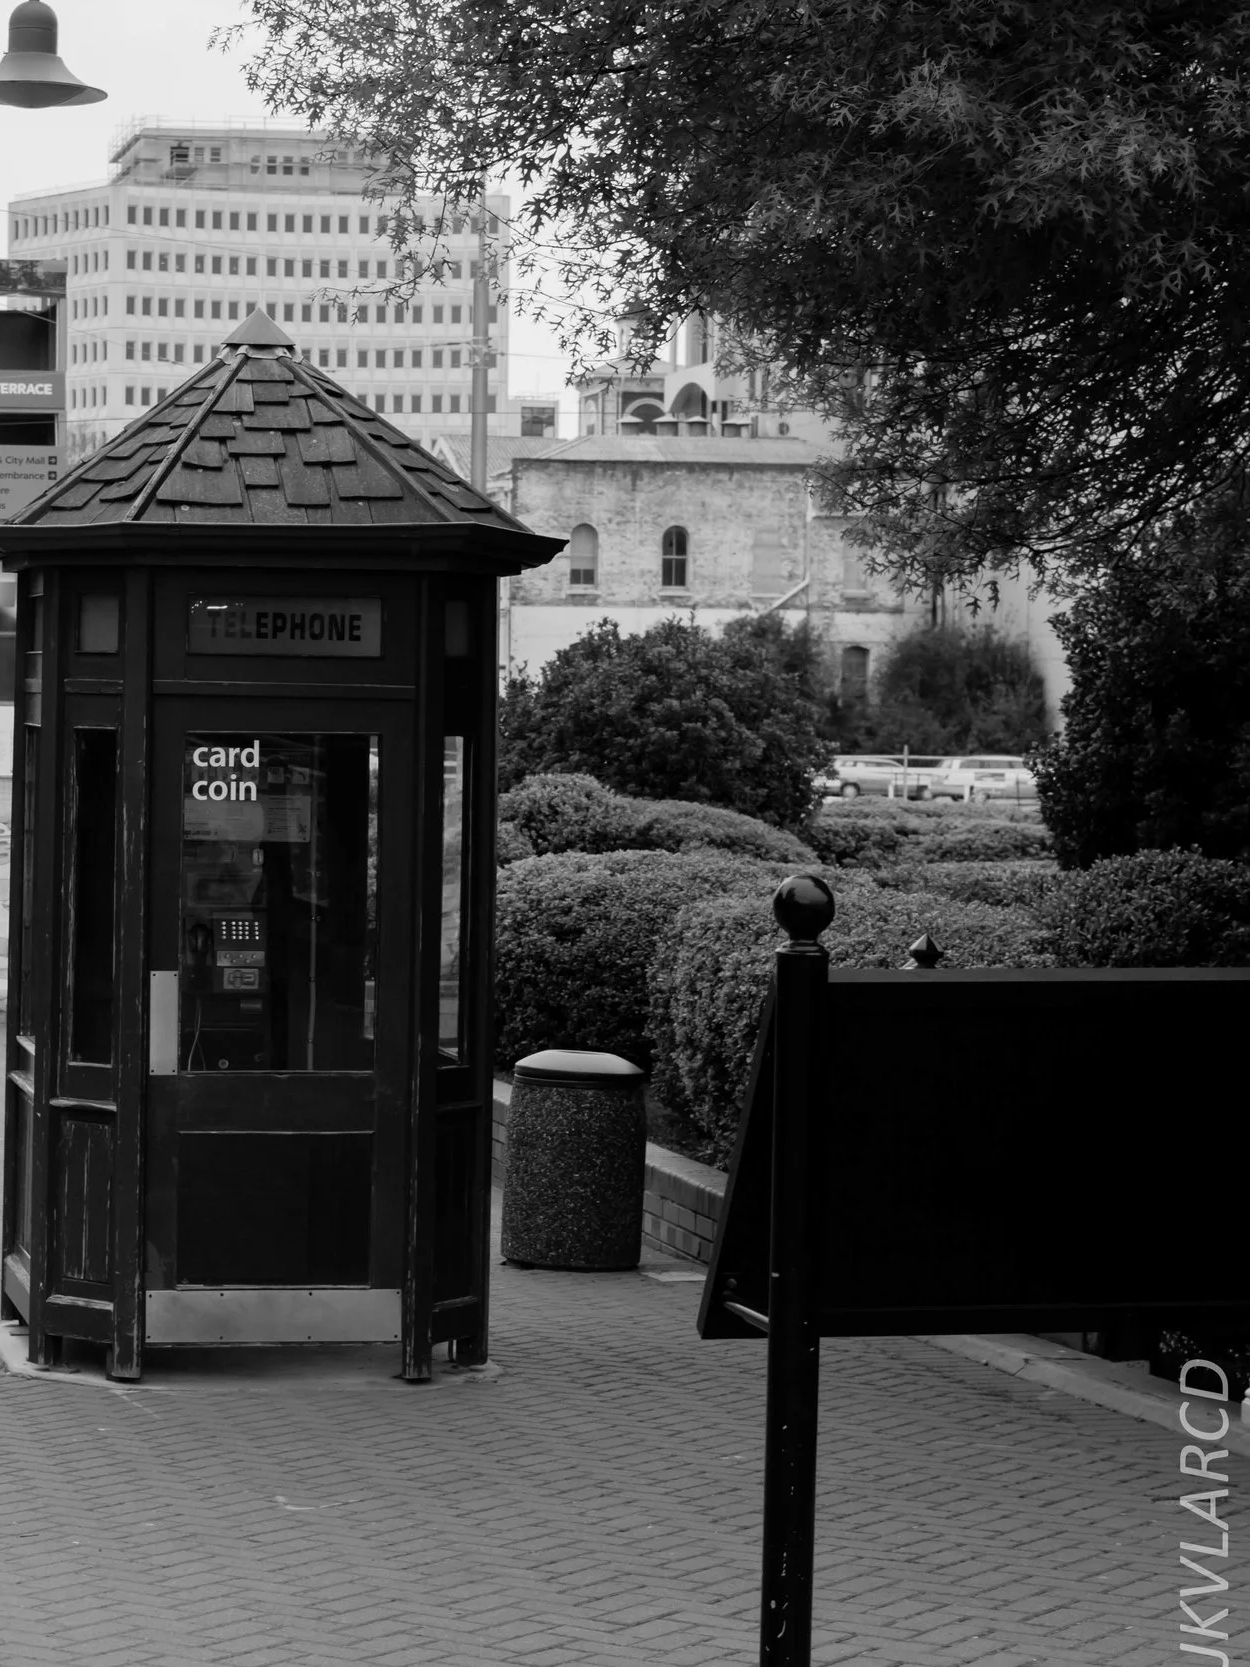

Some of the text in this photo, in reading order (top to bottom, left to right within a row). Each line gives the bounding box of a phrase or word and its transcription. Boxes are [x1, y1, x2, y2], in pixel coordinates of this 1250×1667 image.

[5, 456, 24, 466] City
[26, 456, 45, 465] Mall
[207, 610, 363, 642] TELEPHONE
[192, 739, 260, 768] card
[191, 774, 258, 802] coin
